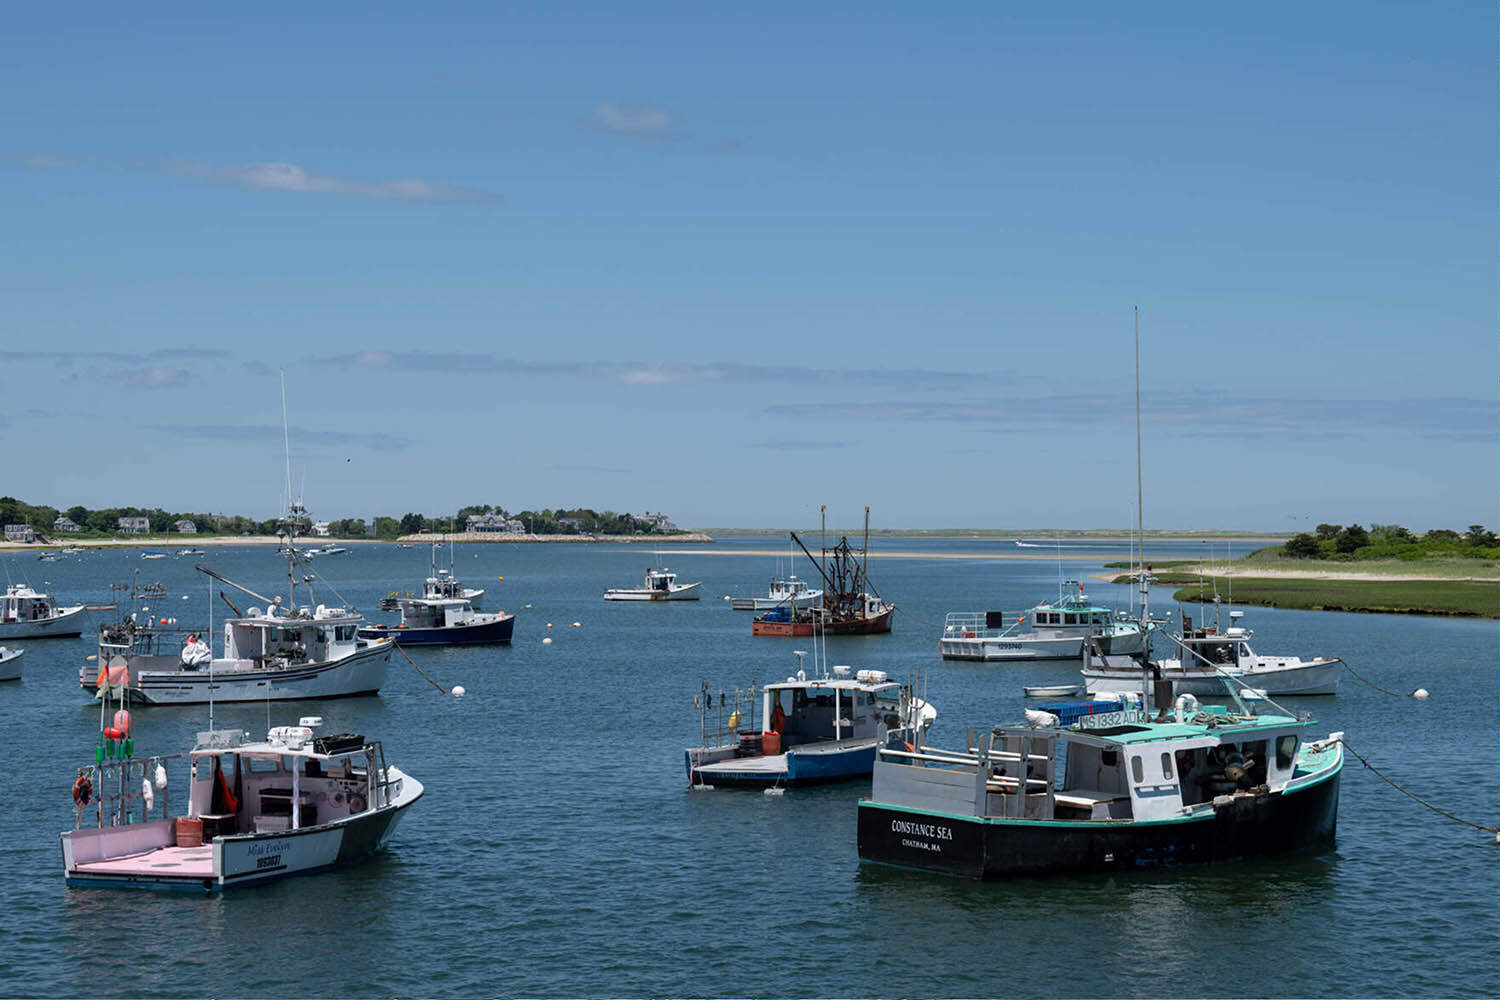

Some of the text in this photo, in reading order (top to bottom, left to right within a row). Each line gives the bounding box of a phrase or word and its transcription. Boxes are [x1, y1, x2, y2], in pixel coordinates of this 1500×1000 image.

[1097, 712, 1121, 728] 1332
[891, 819, 953, 840] CONSTANCE SEA
[931, 843, 942, 852] MA
